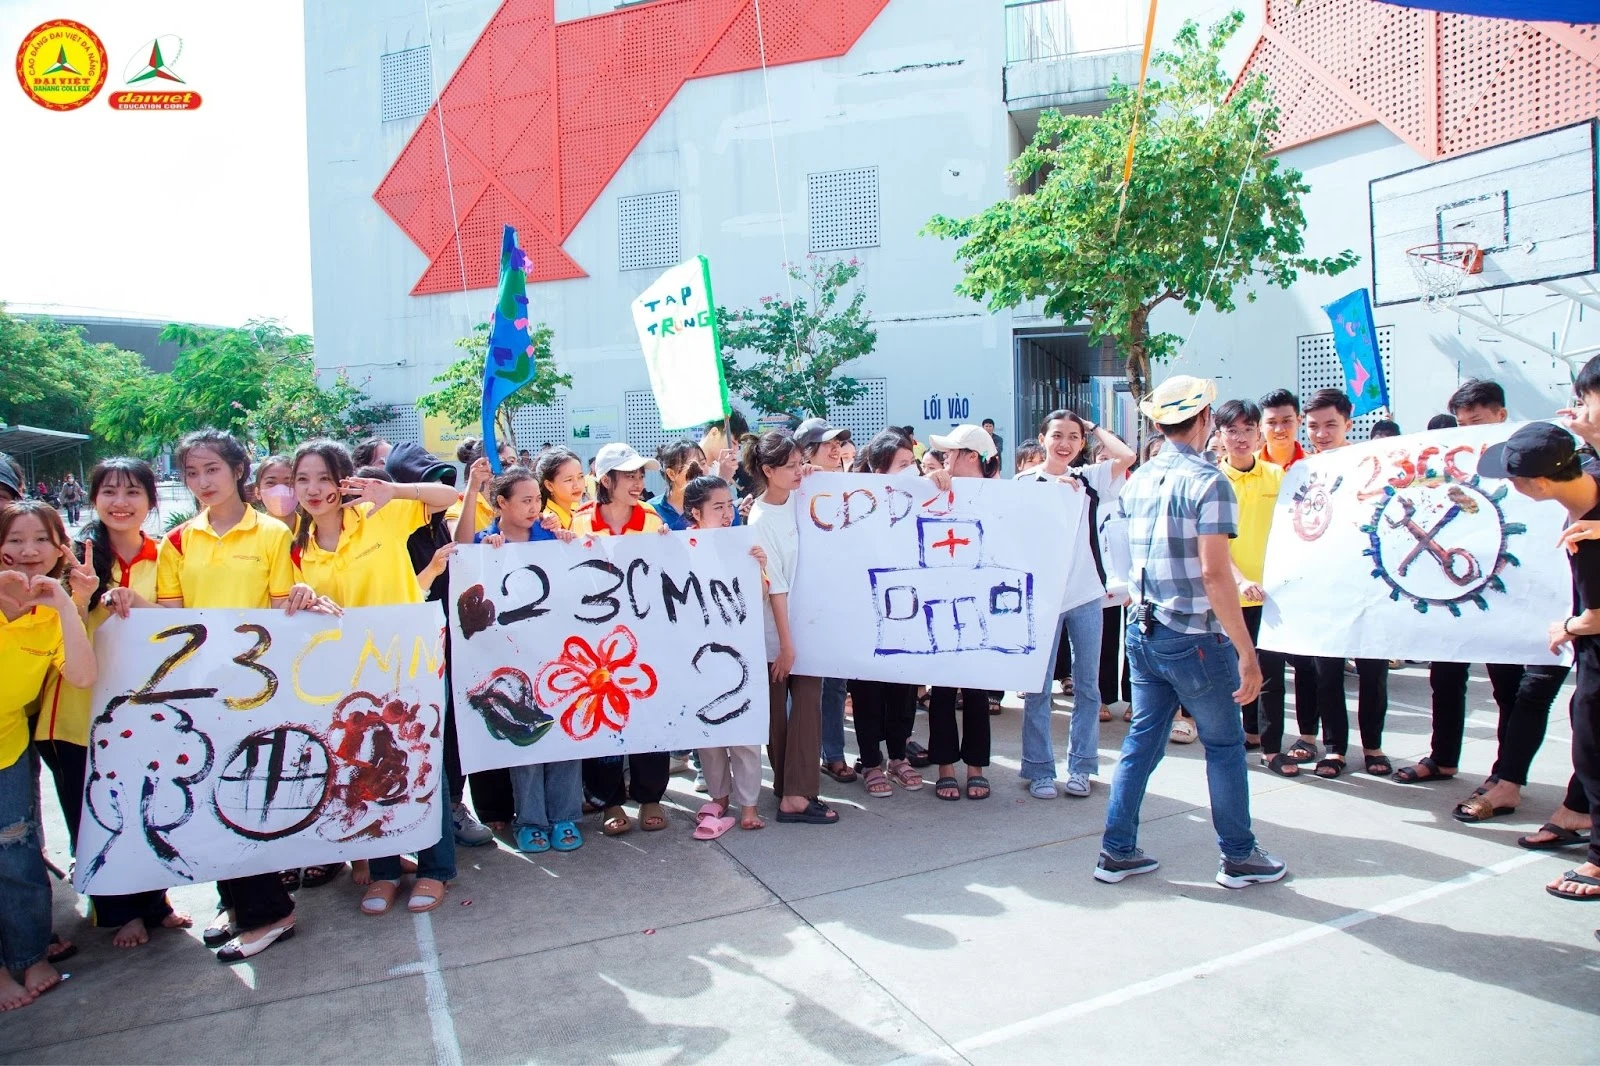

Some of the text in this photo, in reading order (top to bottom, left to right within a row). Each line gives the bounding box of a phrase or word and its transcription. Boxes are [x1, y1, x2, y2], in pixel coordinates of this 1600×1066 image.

[644, 286, 692, 312] TAP
[647, 310, 713, 338] TRUNG
[923, 392, 970, 420] LỐI VÀO
[691, 641, 752, 726] 2
